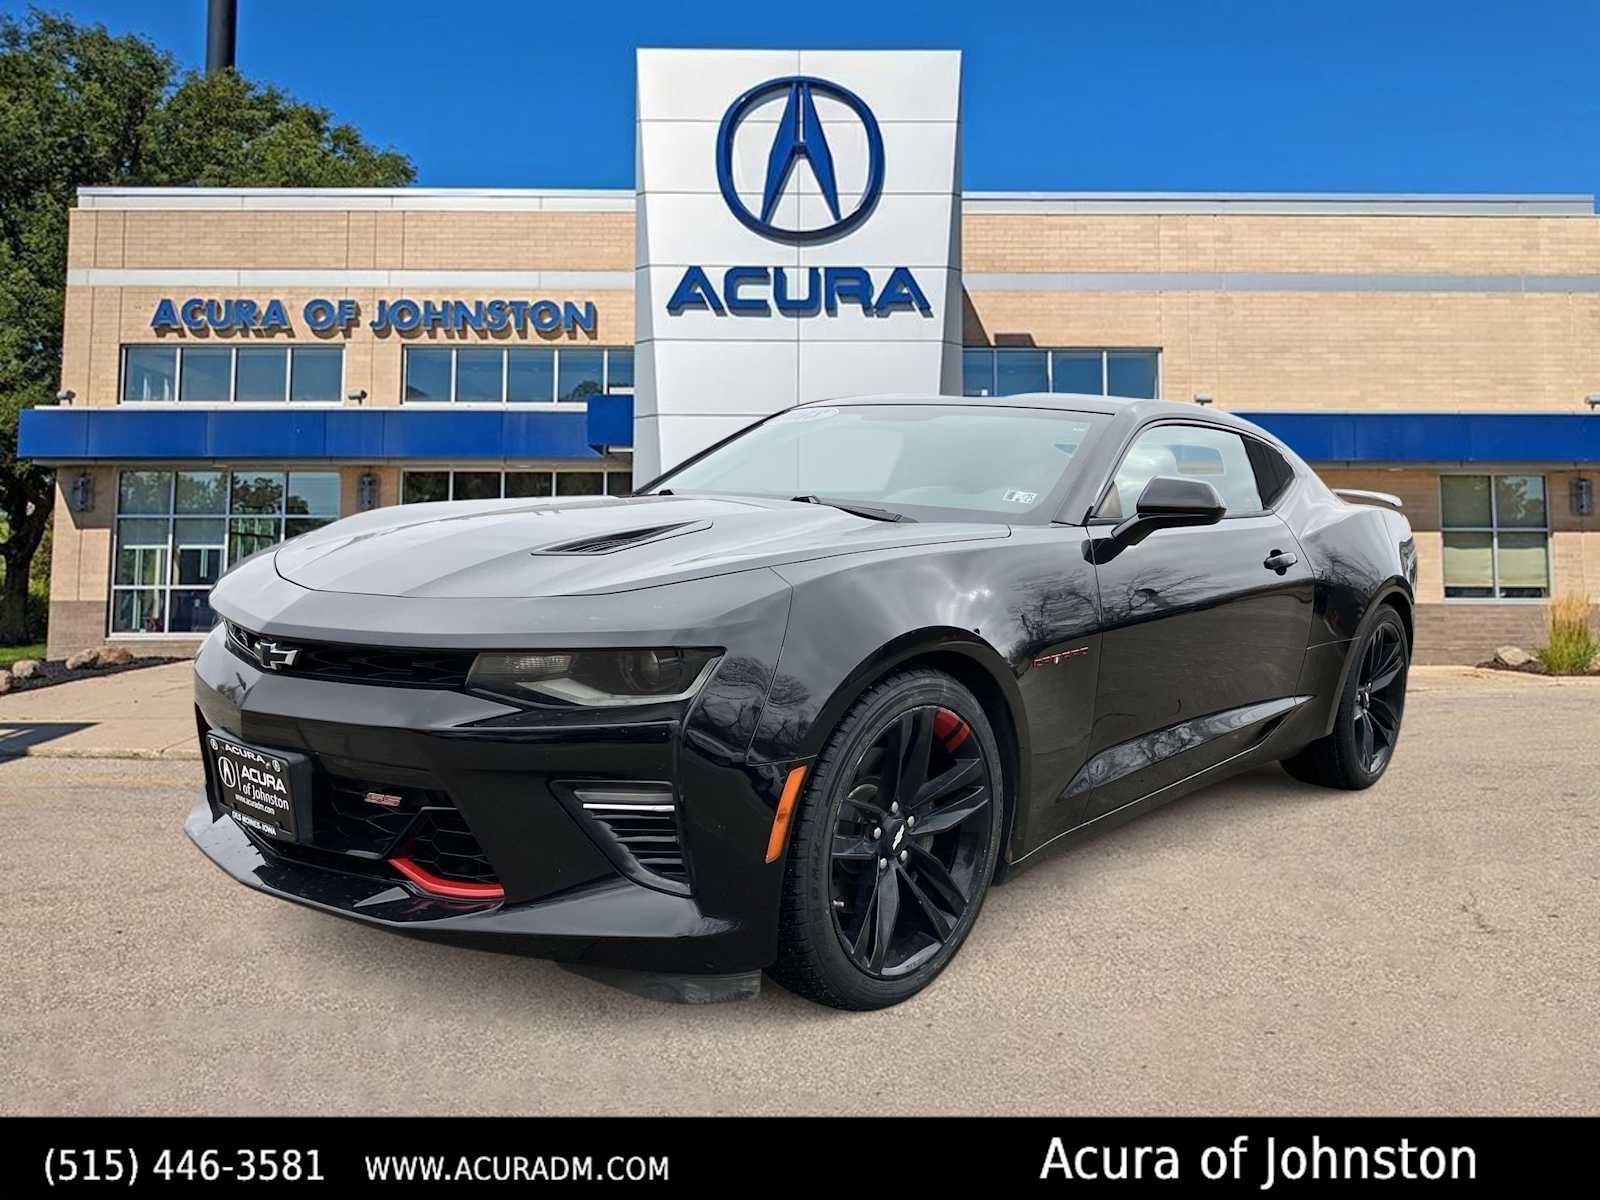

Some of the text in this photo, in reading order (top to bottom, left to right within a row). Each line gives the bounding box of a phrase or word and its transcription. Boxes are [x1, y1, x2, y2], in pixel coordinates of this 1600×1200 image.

[666, 265, 934, 317] ACURA
[150, 298, 598, 334] ACURA OF JOHNSTON
[225, 743, 266, 764] ACURA
[241, 765, 287, 794] ACURA
[243, 782, 289, 811] of Johnston
